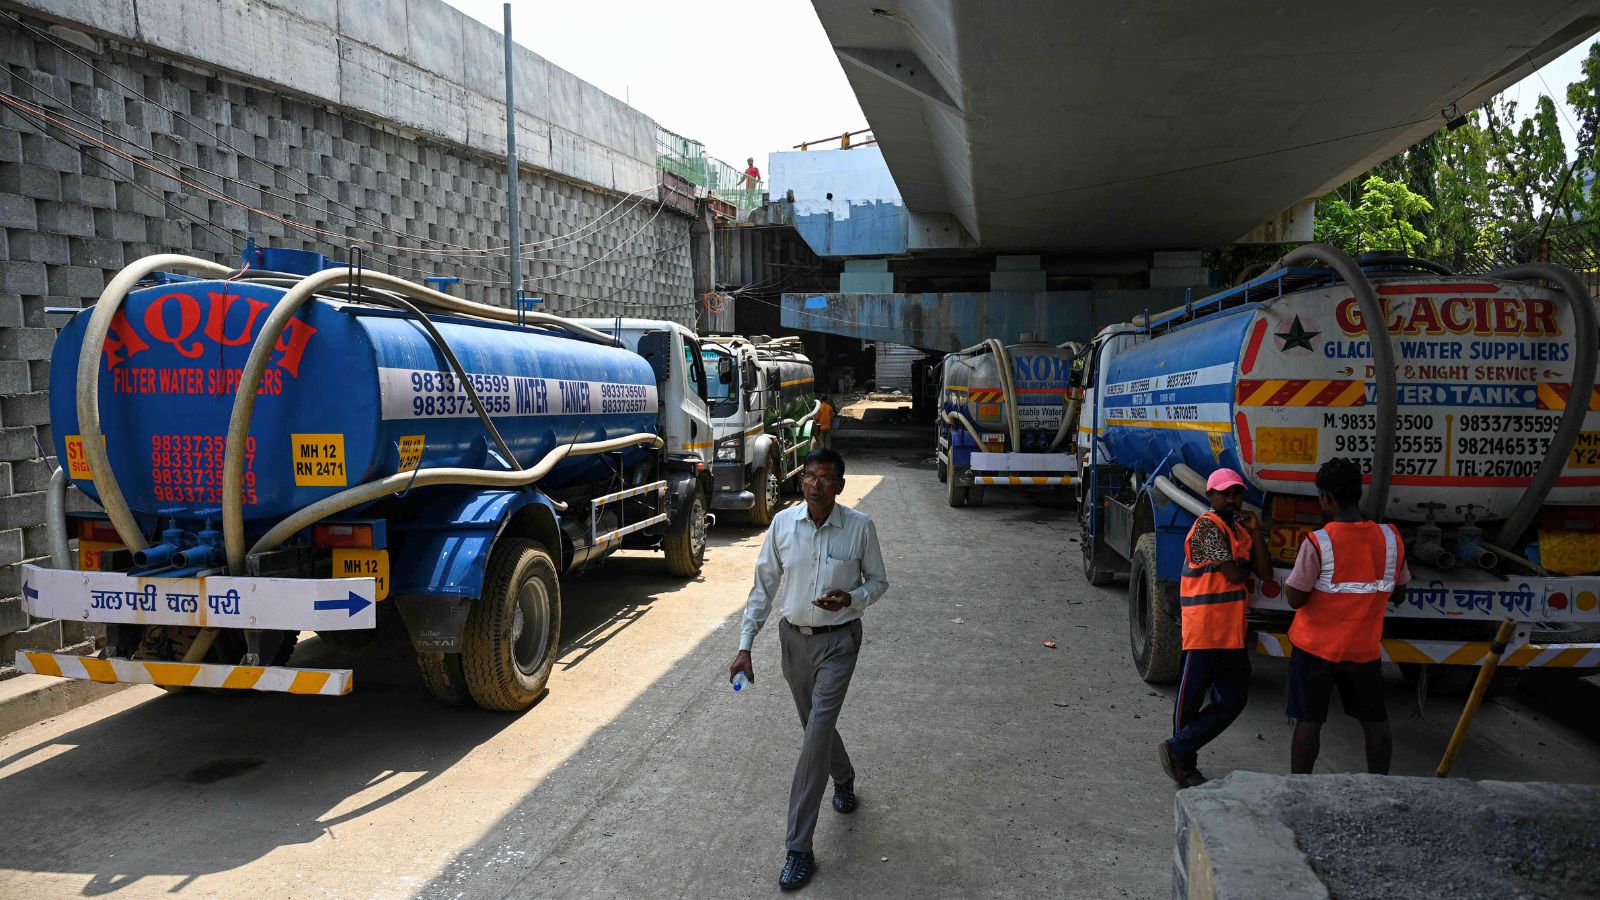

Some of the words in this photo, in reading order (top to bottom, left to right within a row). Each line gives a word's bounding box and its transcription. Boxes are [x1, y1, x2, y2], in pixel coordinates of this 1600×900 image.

[1324, 341, 1374, 358] GLACI
[1401, 341, 1462, 360] WATER
[1470, 341, 1569, 361] SUPPLIERS
[1013, 355, 1072, 381] NOW
[1418, 365, 1469, 380] NIGHT
[1475, 365, 1537, 381] SERVICE
[114, 368, 156, 393] FILTER
[159, 368, 205, 394] WATER
[514, 377, 548, 414] WATER
[558, 380, 591, 414] TANKER
[1451, 385, 1520, 405] TANK
[602, 399, 648, 413] 9833735577
[1018, 407, 1039, 416] otable
[152, 435, 256, 452] 98337350
[300, 444, 318, 458] MH
[323, 444, 336, 458] 12
[1458, 437, 1551, 455] 982146533
[152, 451, 256, 469] 98337357
[296, 461, 312, 476] RN
[316, 461, 343, 476] 2471
[152, 468, 256, 487] 98337359
[344, 559, 361, 573] MH
[365, 559, 378, 573] 12
[165, 593, 199, 614] चल
[208, 588, 240, 615] परी
